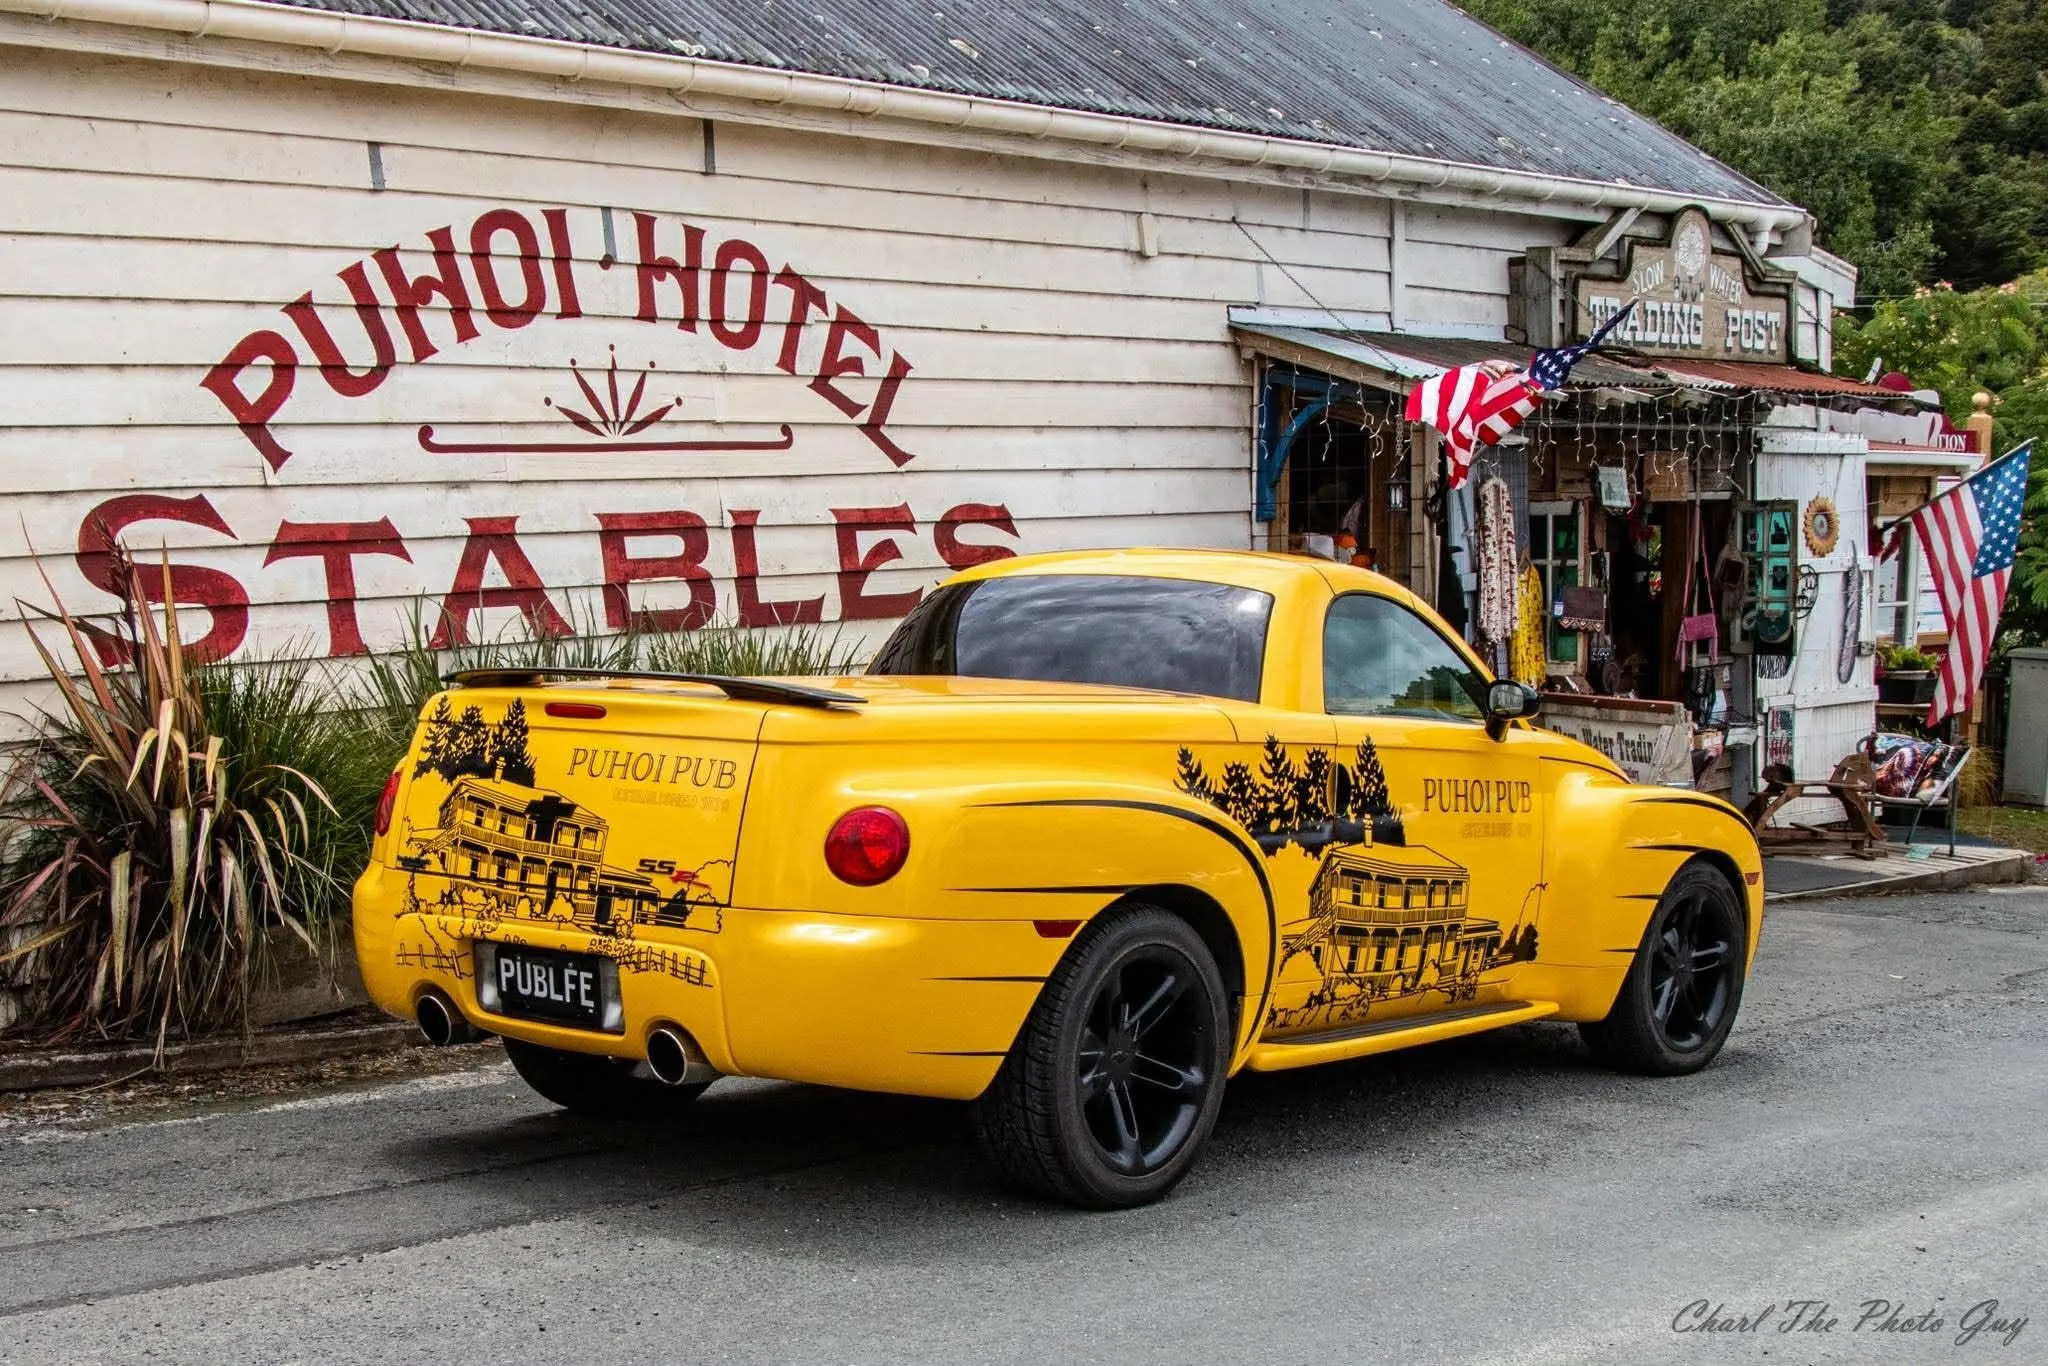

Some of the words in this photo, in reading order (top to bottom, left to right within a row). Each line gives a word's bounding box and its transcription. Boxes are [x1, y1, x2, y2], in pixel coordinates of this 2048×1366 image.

[1632, 259, 1665, 295] SLOW
[1709, 263, 1744, 305] WATER
[200, 208, 583, 474] PUHOI
[633, 210, 917, 469] HOTEL
[1588, 295, 1704, 348] TRADING
[1726, 307, 1781, 353] POST
[74, 492, 1021, 668] STABLES
[567, 747, 668, 783] PUHOI
[669, 755, 738, 789] PUB
[1616, 731, 1657, 764] Tradin
[1423, 778, 1491, 813] PUHOI
[1495, 780, 1533, 814] PUB
[499, 957, 595, 1008] PUBLFE
